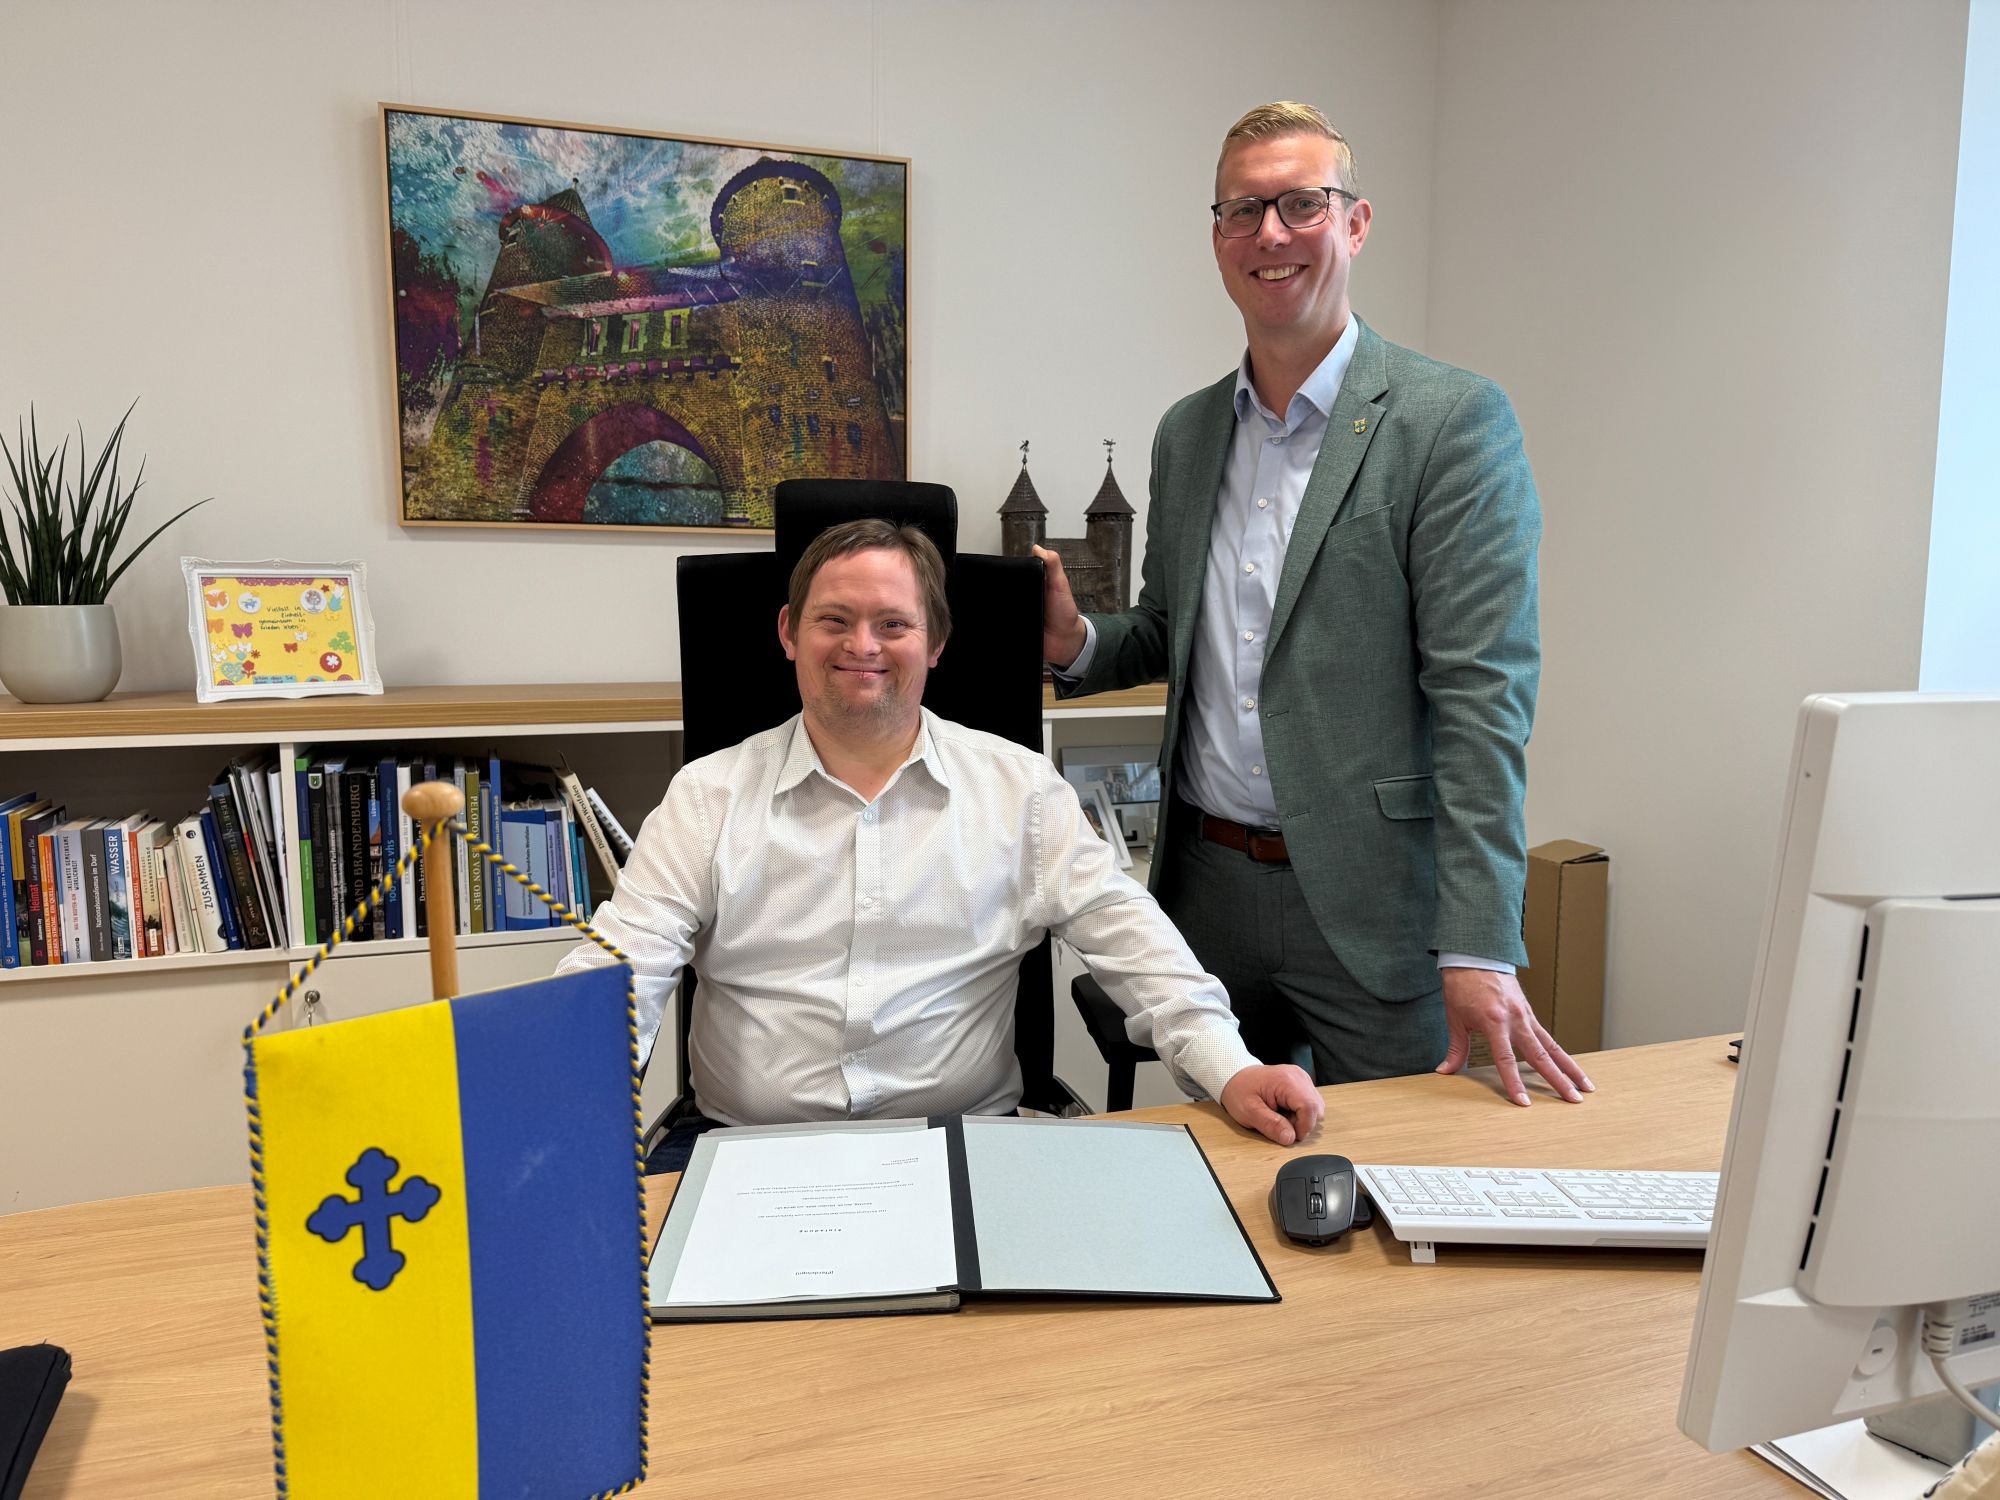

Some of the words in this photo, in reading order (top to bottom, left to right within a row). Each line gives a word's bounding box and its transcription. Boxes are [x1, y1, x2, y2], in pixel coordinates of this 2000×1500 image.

[218, 792, 230, 820] THESE
[572, 784, 587, 816] Westfalen
[350, 784, 364, 875] BRANDENBURG
[585, 814, 591, 823] in
[329, 829, 337, 862] Parlaments
[387, 839, 395, 855] vhs
[589, 822, 605, 849] Dülmen
[89, 853, 97, 866] Dorf
[108, 835, 120, 874] WASSER
[196, 854, 213, 909] ZUSAMMEN
[473, 861, 481, 881] VON
[29, 882, 40, 911] Heimat
[93, 875, 102, 927] Nationalsozialismus
[474, 884, 482, 911] OBEN
